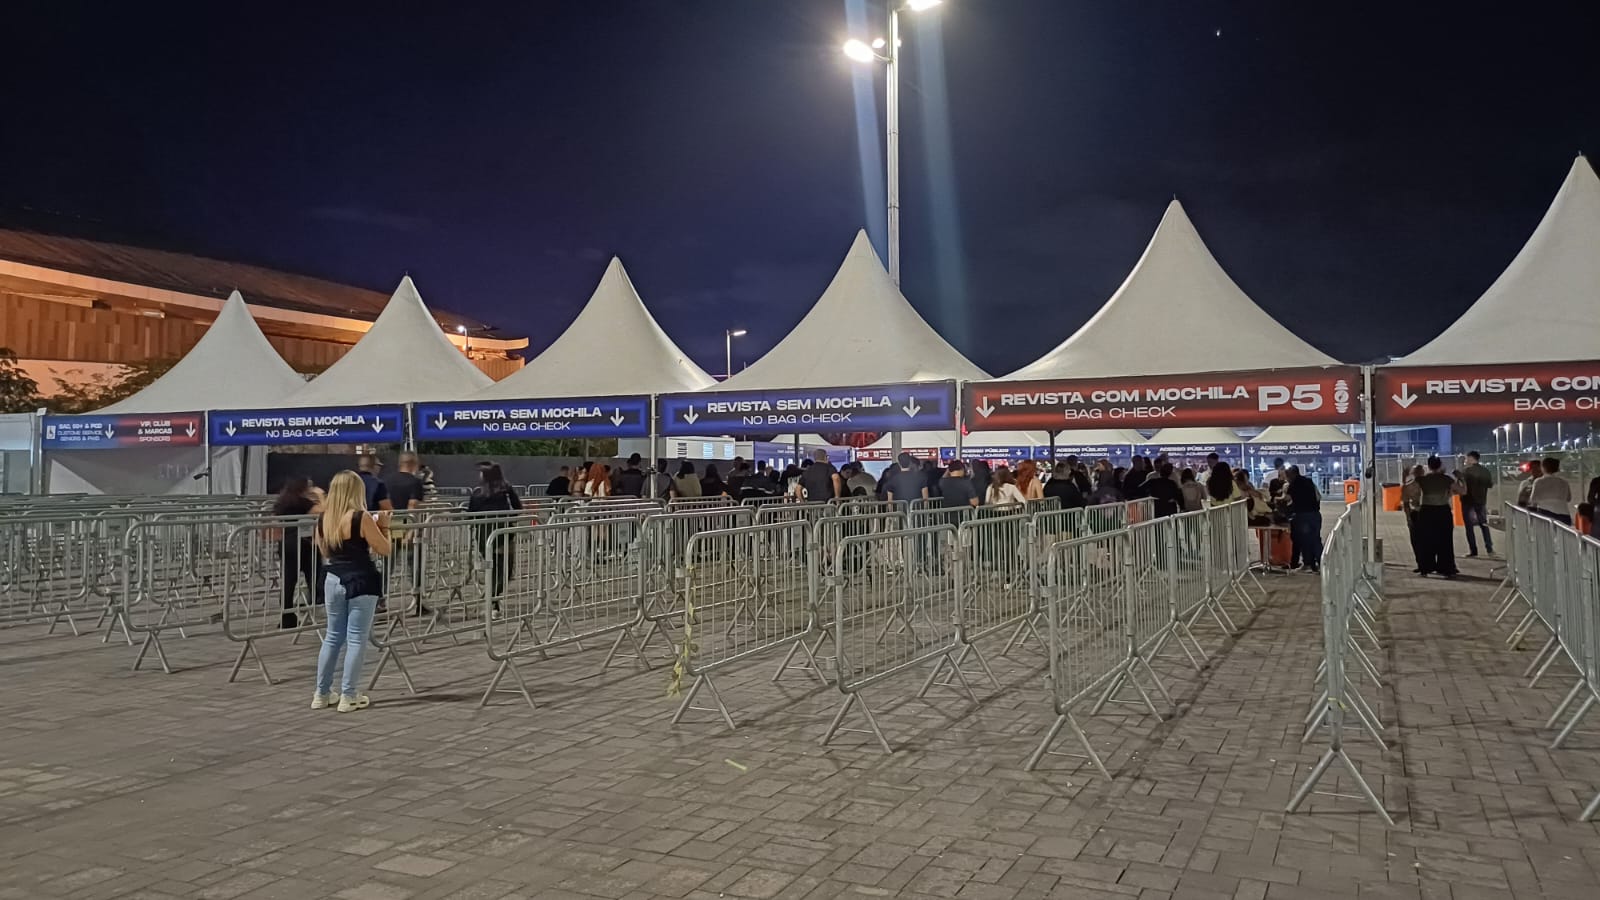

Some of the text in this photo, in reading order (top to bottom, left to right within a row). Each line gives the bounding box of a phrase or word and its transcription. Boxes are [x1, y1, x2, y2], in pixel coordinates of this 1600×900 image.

[1426, 378, 1542, 394] REVISTA
[1001, 385, 1250, 406] REVISTA COM MOCHILA
[1258, 384, 1322, 412] P5
[708, 396, 892, 413] REVISTA SEM MOCHILA
[1514, 397, 1566, 411] BAG
[454, 407, 601, 420] REVISTA SEM MOCHILA
[743, 413, 852, 426] NO BAG CHECK
[1065, 406, 1177, 420] BAG CHECK
[242, 416, 365, 428] REVISTA SEM MOCHILA
[483, 421, 571, 432] NO BAG CHECK
[144, 427, 173, 435] MARCAS
[266, 429, 339, 438] NO BAG CHECK
[1332, 445, 1350, 453] P5
